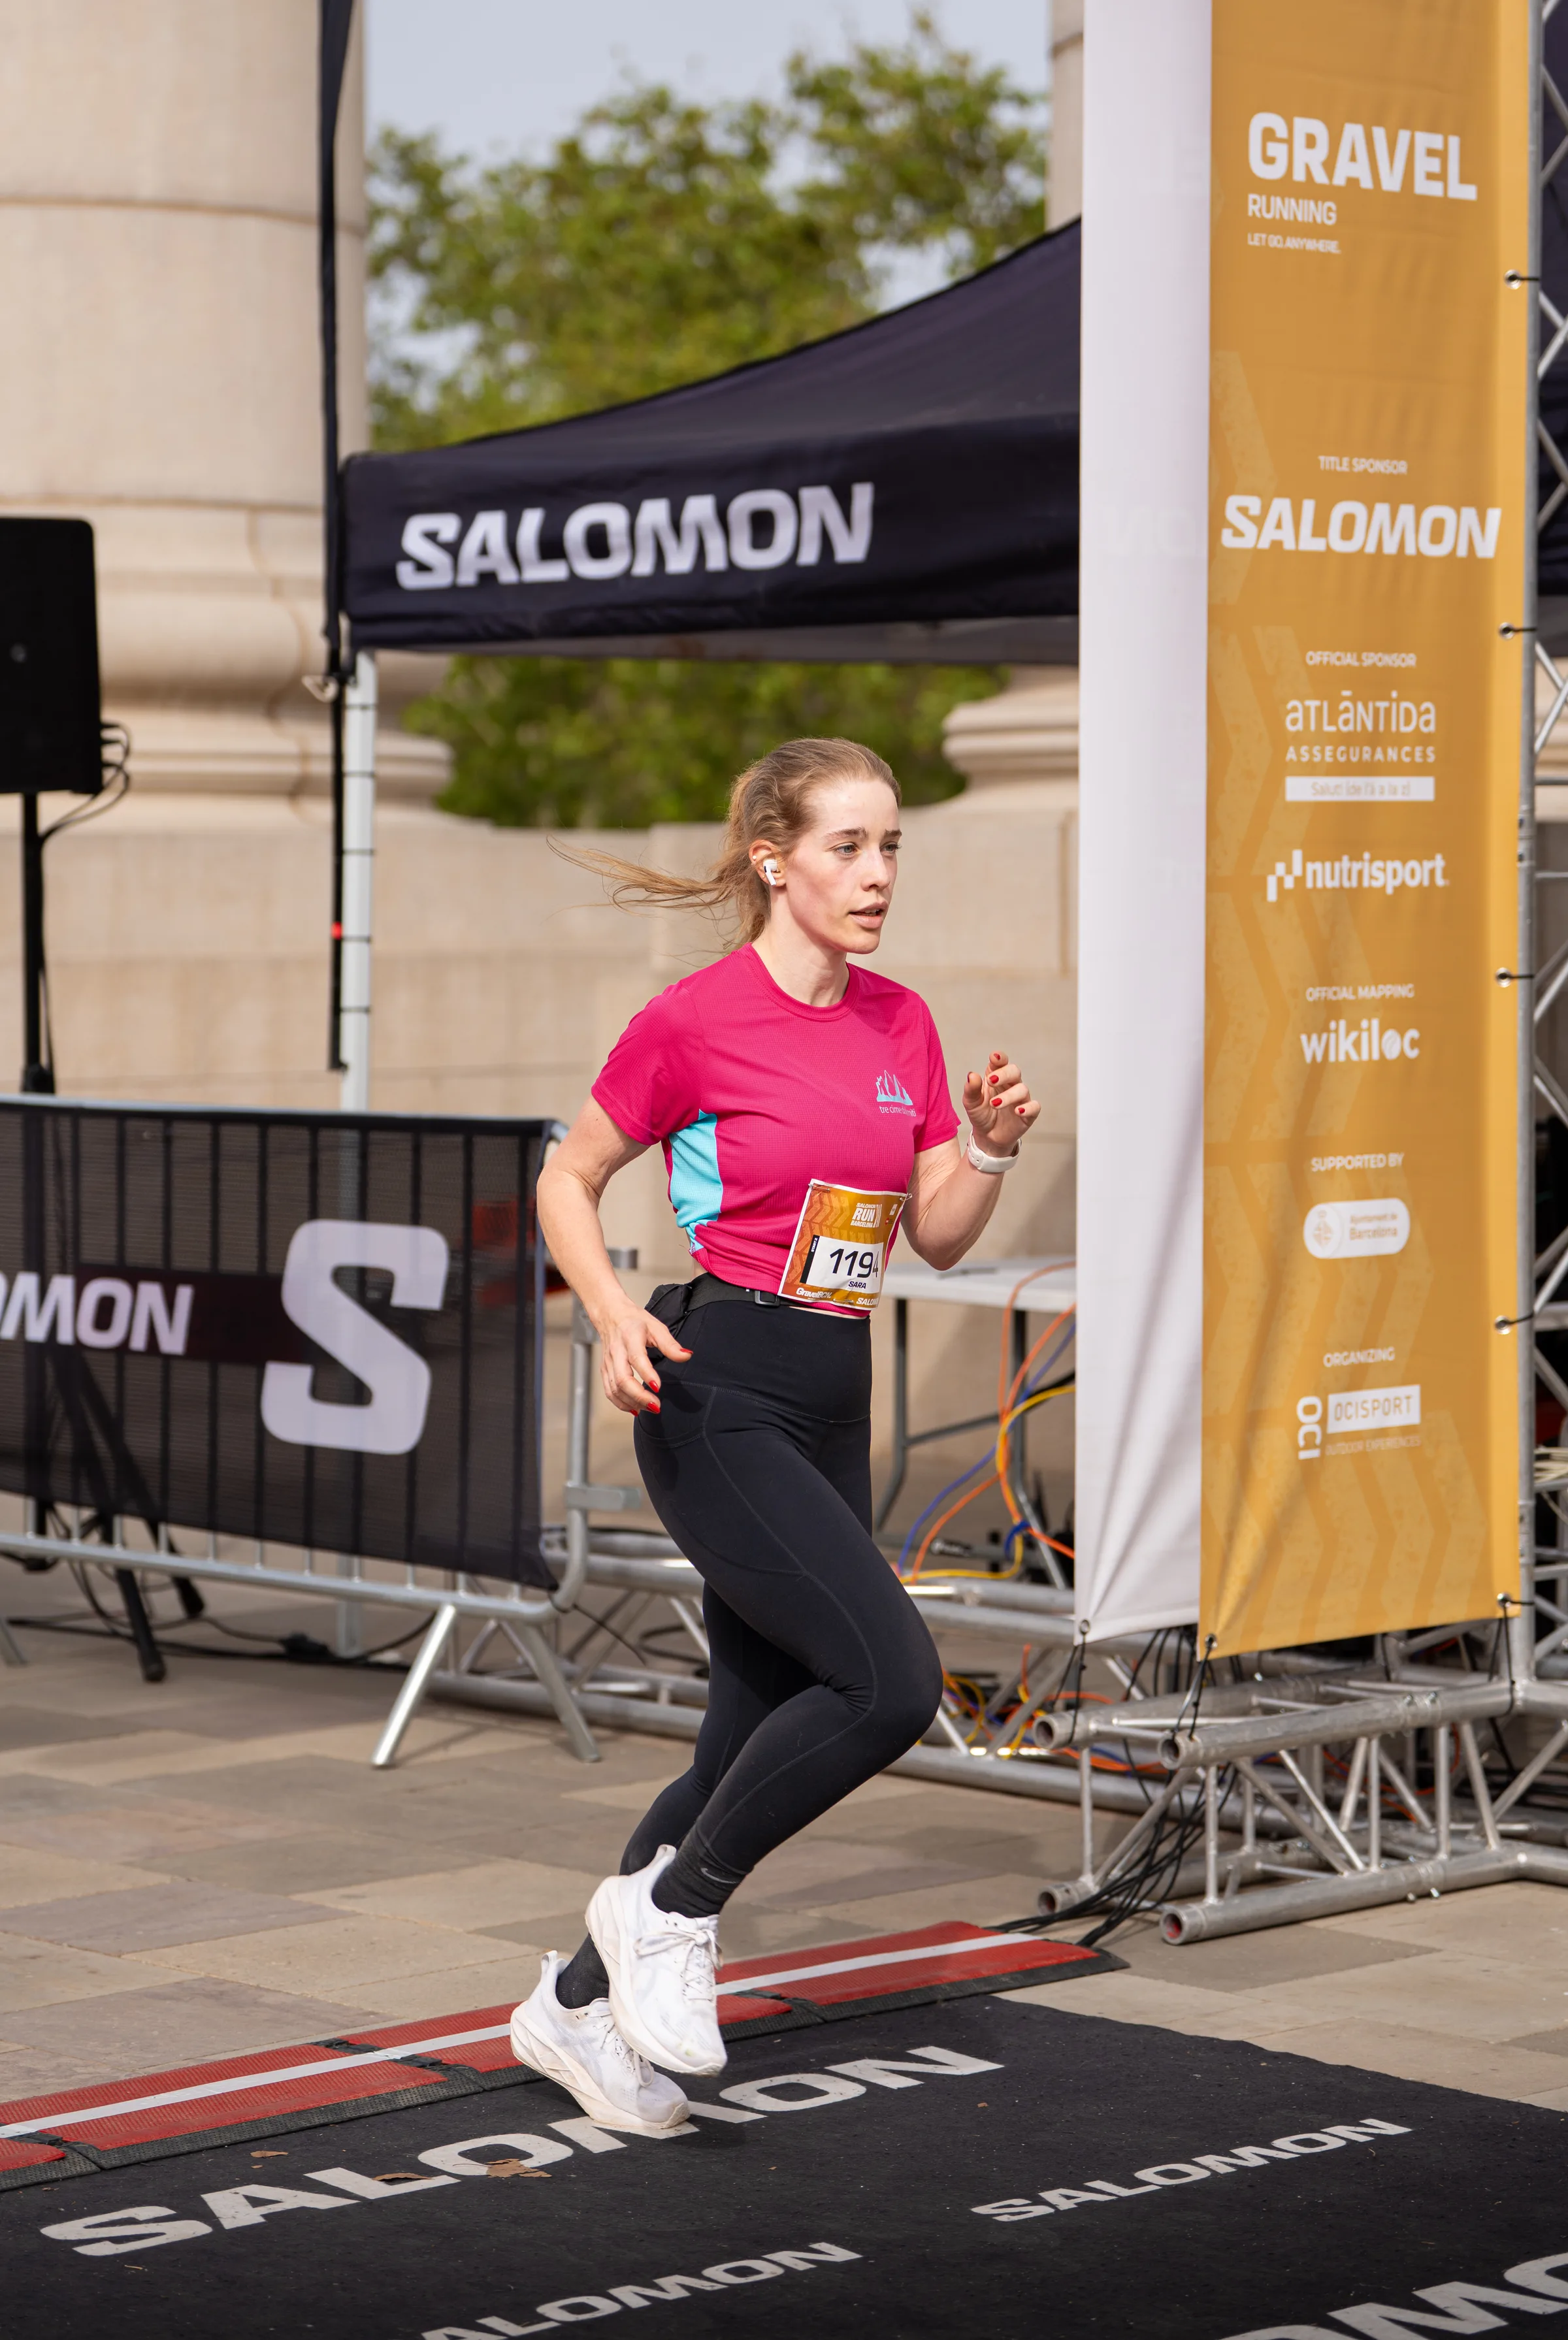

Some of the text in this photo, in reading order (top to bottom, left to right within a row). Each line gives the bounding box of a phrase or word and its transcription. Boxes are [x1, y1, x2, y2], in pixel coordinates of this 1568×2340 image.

[1249, 112, 1477, 201] GRAVEL
[1248, 194, 1337, 225] RUNNING
[1247, 232, 1266, 246] LET
[1318, 455, 1408, 474] TITLE SPONSOR
[396, 482, 874, 591] SALOMON
[1221, 495, 1501, 559] SALOMON
[1305, 651, 1417, 668] OFFICIAL SPONSOR
[1285, 746, 1435, 762] ASSEGURANCES
[1305, 851, 1446, 895] nutrisport
[1306, 983, 1414, 1001] OFFICIAL MAPPING
[1300, 1018, 1420, 1064] wikiloc
[1311, 1152, 1404, 1172] SUPPORTED BY
[852, 1208, 875, 1222] RUN
[830, 1248, 879, 1278] 1194
[261, 1219, 449, 1455] S
[1323, 1346, 1395, 1367] ORGANIZING
[1334, 1395, 1413, 1422] OCISPORT
[1296, 1395, 1322, 1460] OCI
[970, 2119, 1413, 2222] SALOMON
